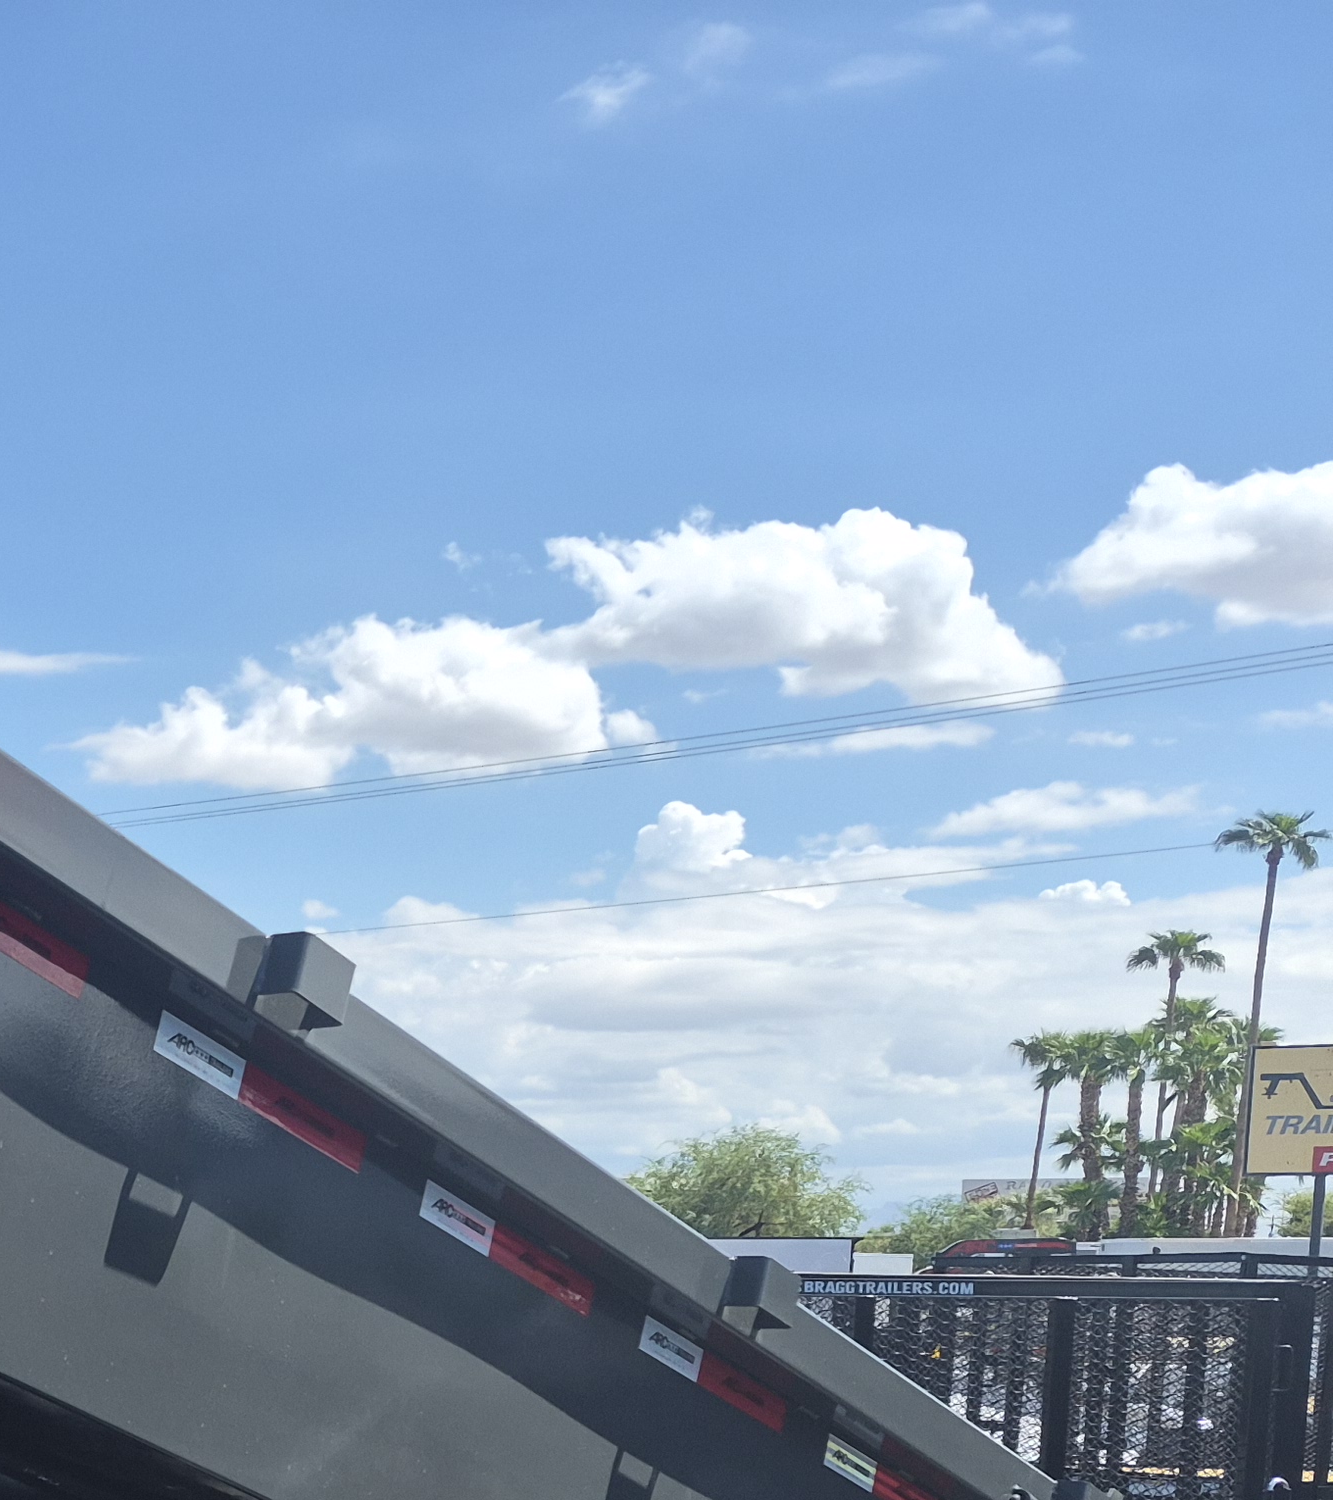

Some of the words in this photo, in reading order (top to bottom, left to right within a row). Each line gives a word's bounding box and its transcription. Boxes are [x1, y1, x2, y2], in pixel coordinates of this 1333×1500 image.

[167, 1032, 195, 1056] ARC
[1266, 1114, 1333, 1135] TRAI
[430, 1198, 456, 1220] ARC
[800, 1280, 974, 1295] BRAGGTRAILERS.COM
